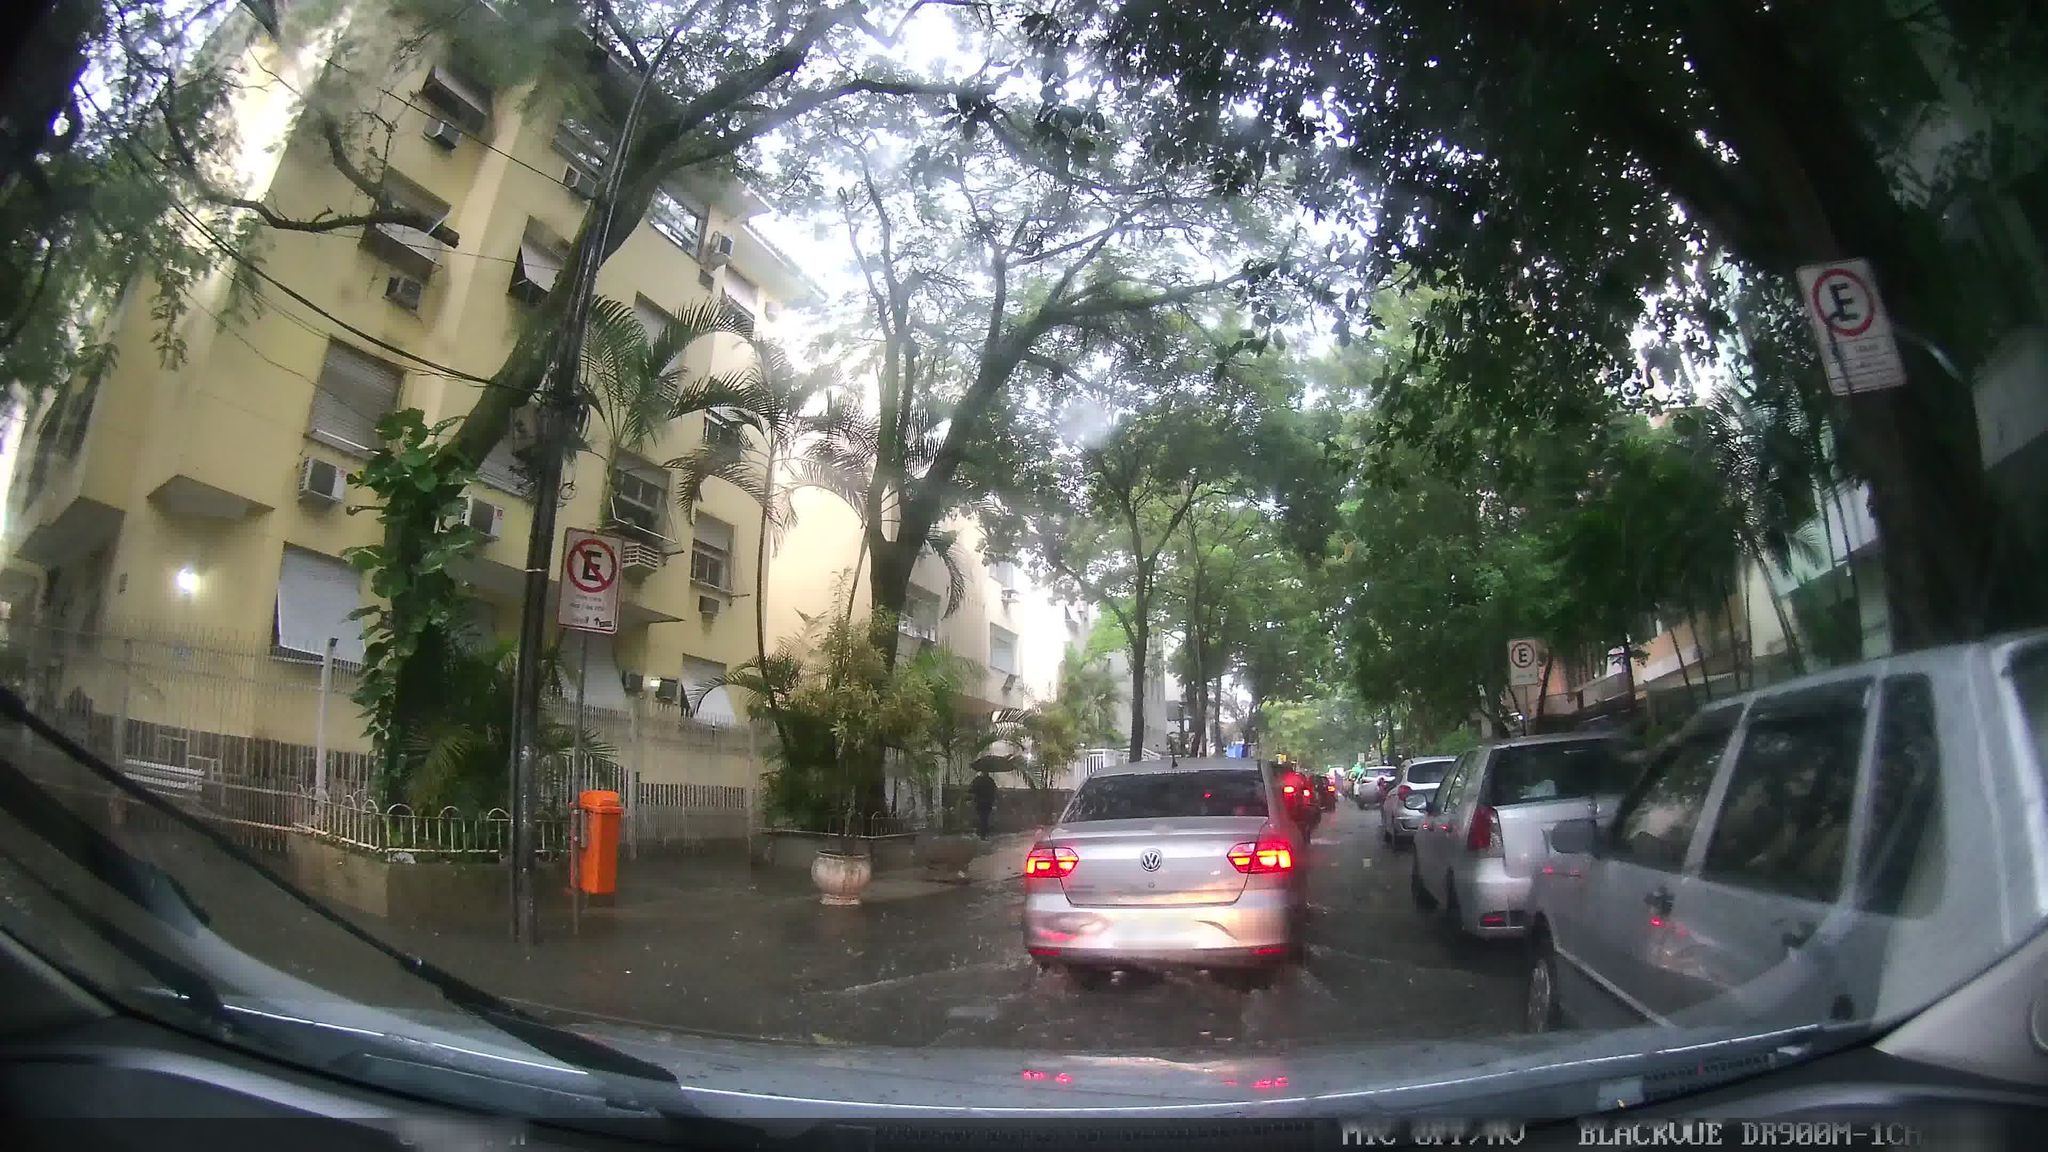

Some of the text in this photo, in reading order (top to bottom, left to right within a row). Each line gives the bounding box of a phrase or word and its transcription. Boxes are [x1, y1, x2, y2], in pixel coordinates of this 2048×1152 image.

[1829, 283, 1859, 321] E
[582, 550, 602, 581] E
[1518, 648, 1528, 663] E
